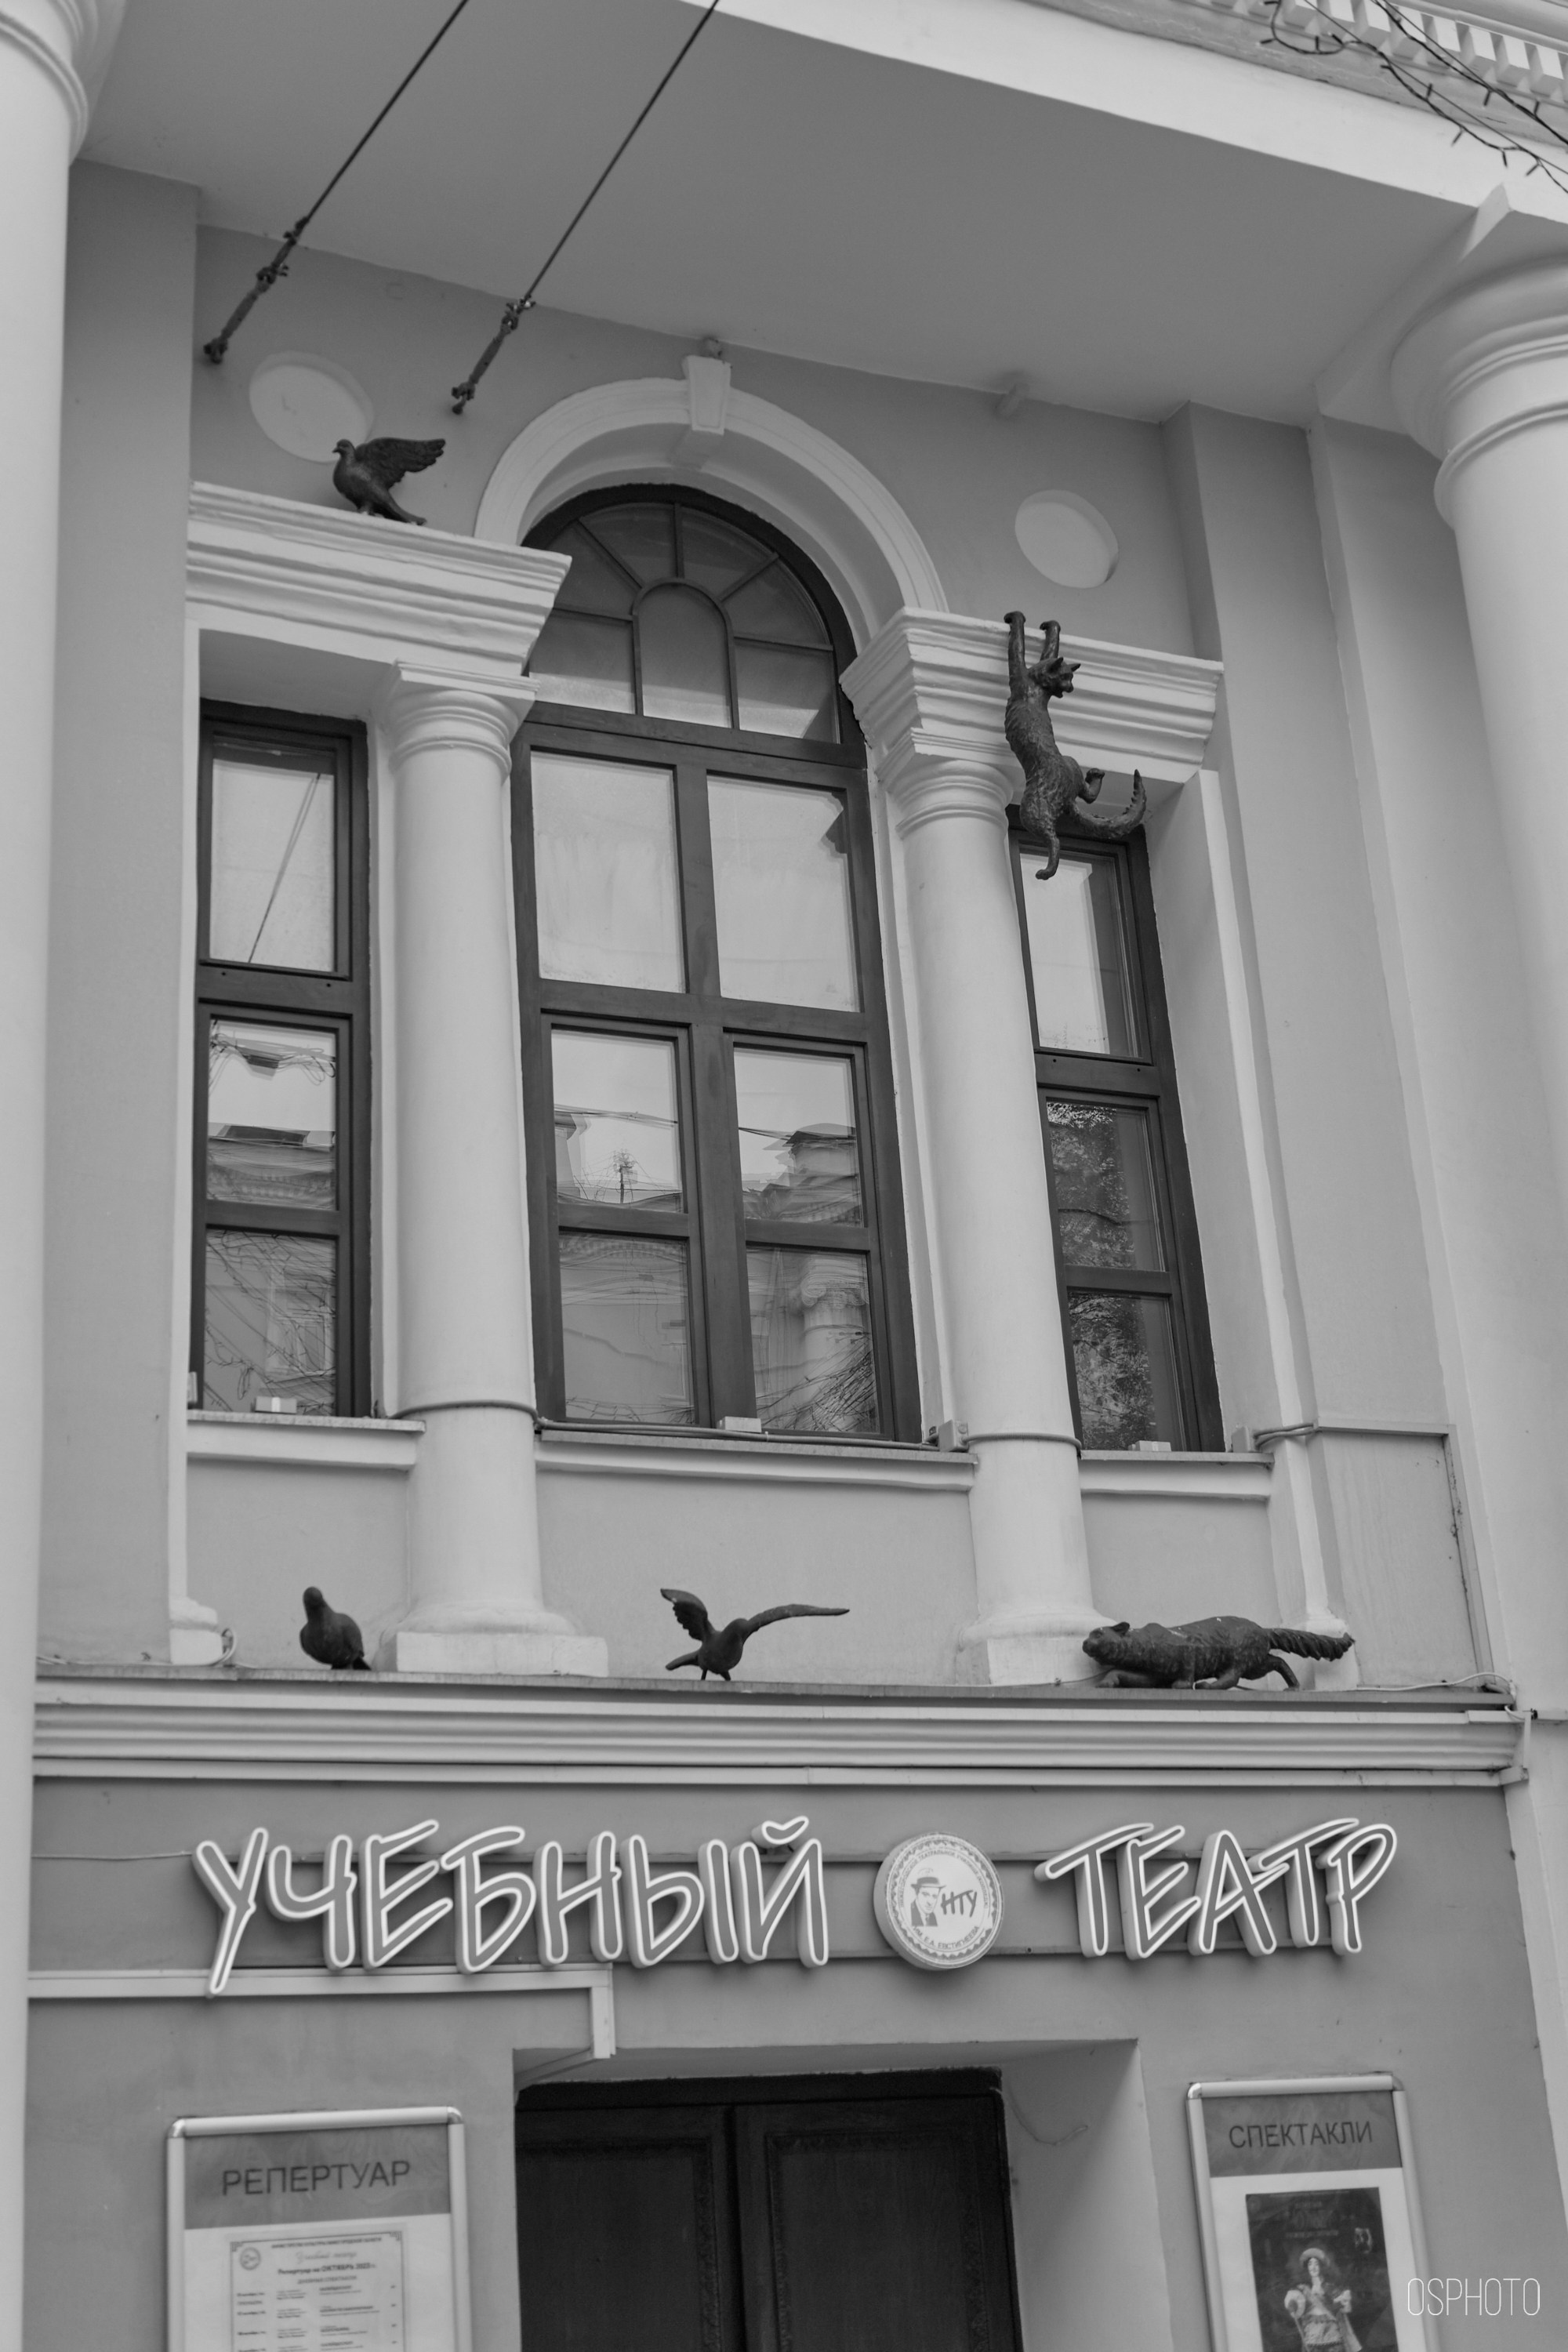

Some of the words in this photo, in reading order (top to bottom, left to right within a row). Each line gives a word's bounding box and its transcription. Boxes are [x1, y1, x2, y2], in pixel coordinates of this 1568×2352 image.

[194, 1815, 829, 1997] УЧЕБНЫЙ
[1034, 1817, 1397, 1960] ТЕАТР
[940, 1889, 978, 1918] НТУ
[1229, 2120, 1374, 2149] СПЕКТАКЛИ
[222, 2160, 411, 2196] РЕПЕРТУАР
